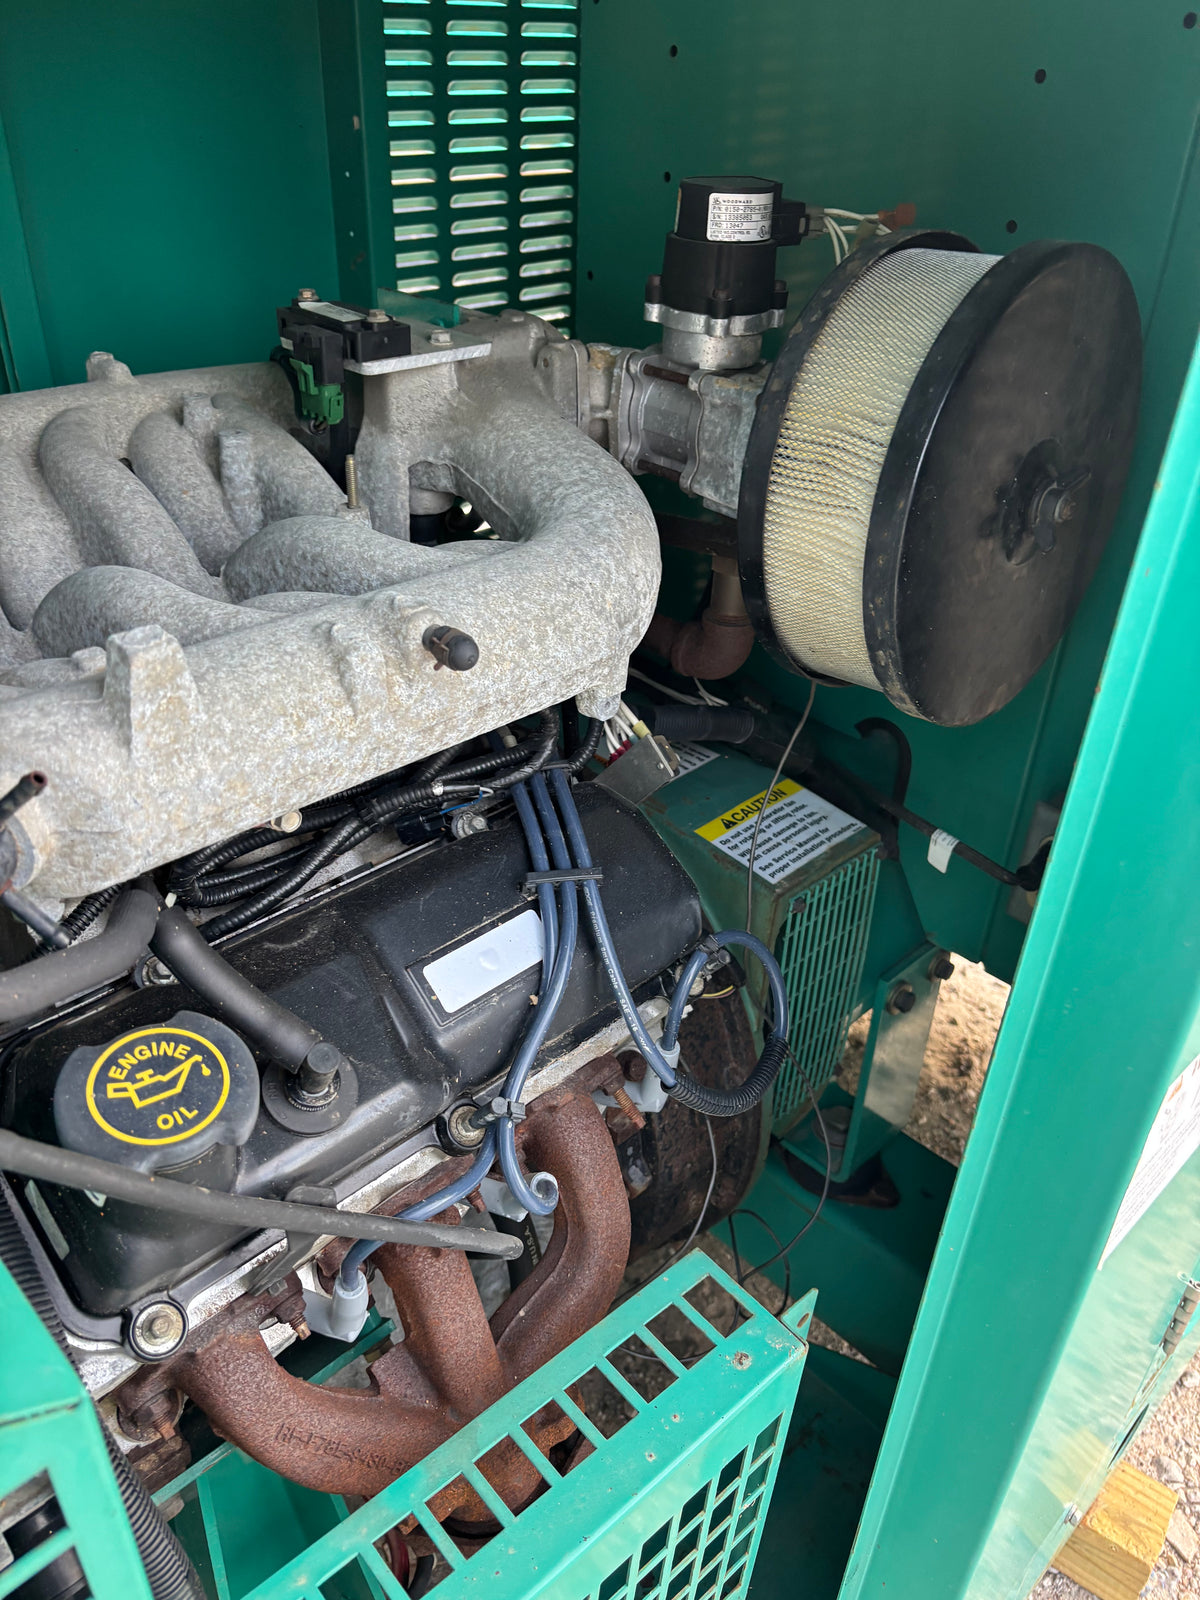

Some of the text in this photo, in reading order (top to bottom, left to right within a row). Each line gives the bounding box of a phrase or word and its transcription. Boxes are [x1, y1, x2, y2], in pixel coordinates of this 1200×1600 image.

[719, 838, 731, 846] Do
[730, 831, 743, 840] not
[742, 824, 755, 833] use
[783, 800, 797, 808] fan
[730, 788, 788, 822] CAUTON
[727, 843, 739, 851] for
[764, 822, 773, 830] or
[770, 811, 793, 825] lifting
[754, 836, 773, 850] cause
[772, 821, 798, 838] damage
[758, 826, 831, 872] See Service Manual for
[761, 841, 783, 855] cause
[780, 823, 810, 844] personal
[768, 861, 791, 879] proper
[788, 839, 827, 863] installation
[607, 968, 618, 989] Cable
[620, 998, 631, 1014] SAE
[108, 1041, 191, 1080] ENGINE
[157, 1107, 199, 1130] OIL
